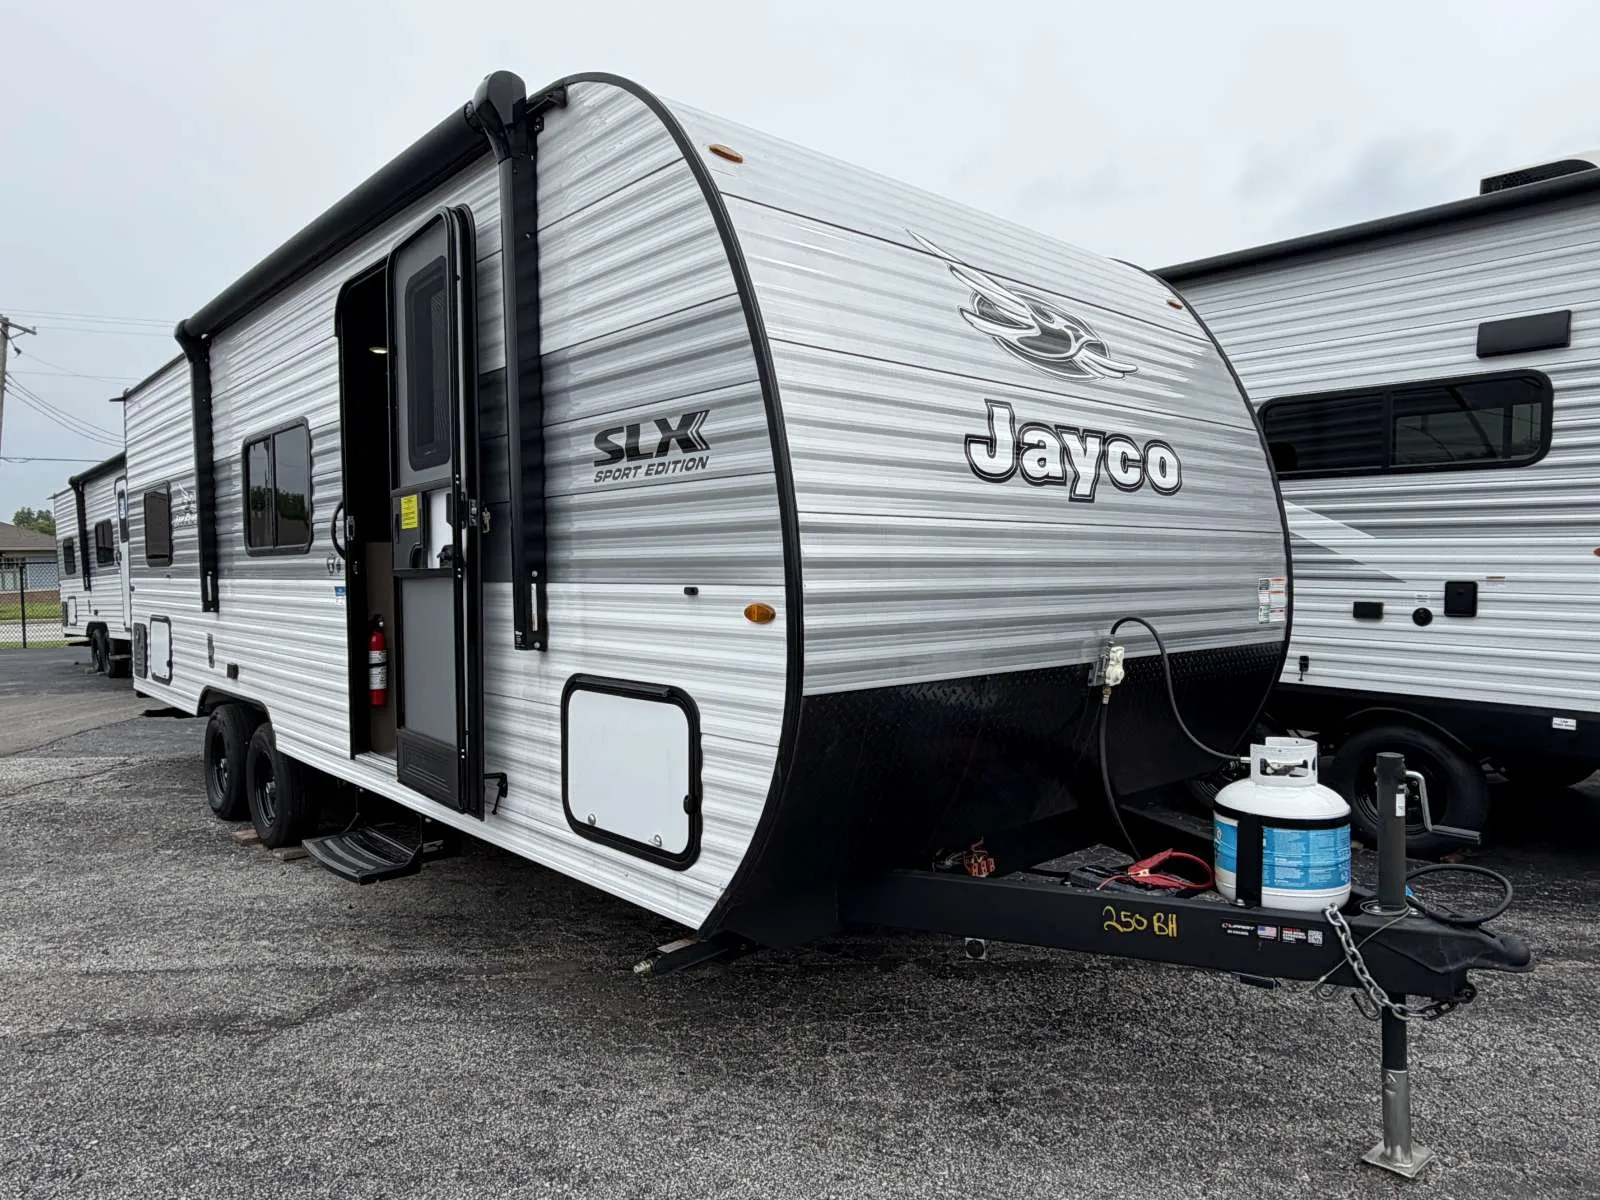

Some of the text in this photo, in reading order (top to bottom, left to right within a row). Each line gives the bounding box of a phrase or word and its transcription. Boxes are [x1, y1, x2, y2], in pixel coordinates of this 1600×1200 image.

[594, 409, 711, 467] SLX
[964, 398, 1182, 503] Jayco
[593, 456, 710, 483] SPORT EDITION
[1102, 905, 1177, 938] 250 BH
